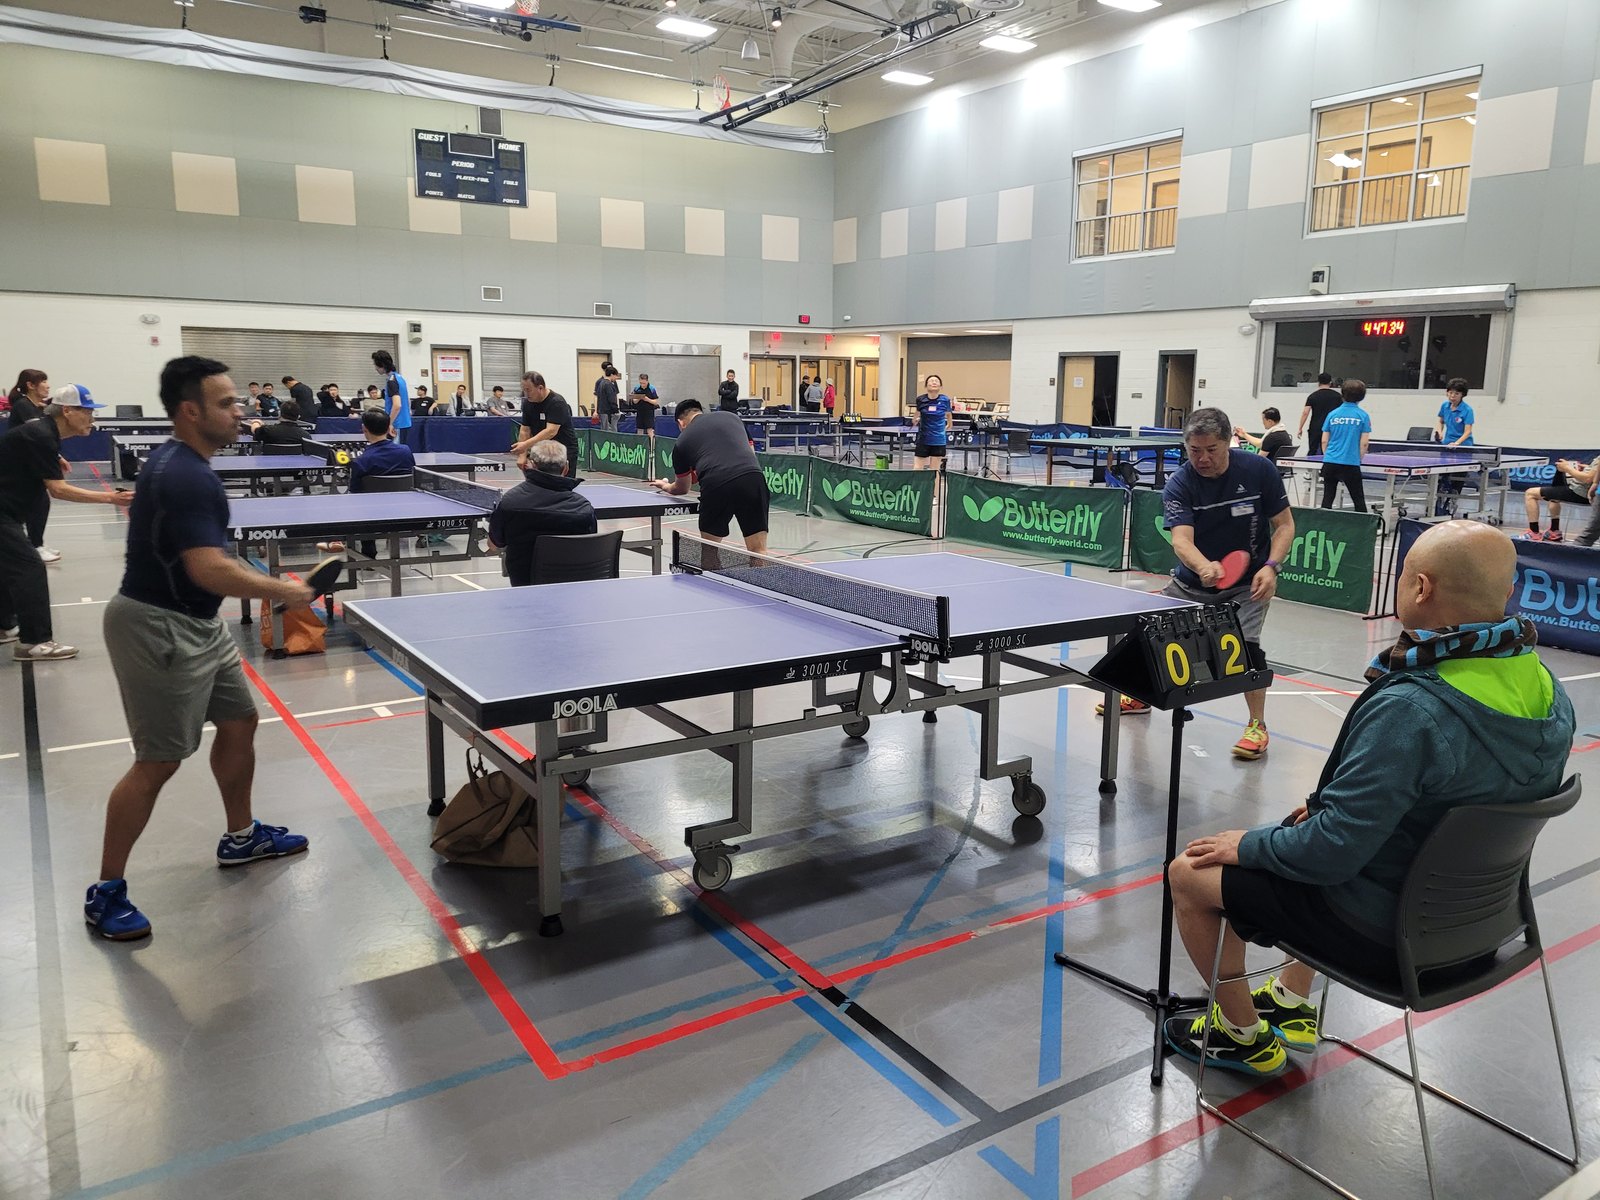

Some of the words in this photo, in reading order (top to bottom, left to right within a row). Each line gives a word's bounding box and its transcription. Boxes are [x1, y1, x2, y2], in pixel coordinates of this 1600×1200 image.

[417, 132, 445, 142] GUEST
[498, 142, 521, 152] HOME
[451, 160, 475, 168] PERIOD
[336, 451, 350, 464] 6
[610, 441, 647, 468] Butterfly
[763, 466, 804, 500] tterfly
[851, 480, 921, 517] Butterfly
[663, 506, 690, 516] JOOLA
[849, 508, 921, 524] www.butterfly-world.com
[437, 519, 455, 528] 3000
[458, 519, 467, 527] SC
[1003, 498, 1102, 542] Butterfly
[248, 529, 287, 540] JOOLA
[1002, 530, 1102, 551] www.butterfly-world.com
[1283, 530, 1347, 578] rfly
[911, 638, 940, 655] JOOLA
[988, 635, 1012, 650] 3000
[1016, 633, 1027, 646] SC
[1220, 633, 1245, 676] 2
[802, 661, 830, 677] 3000
[836, 659, 849, 672] SC
[1165, 642, 1190, 686] 0
[552, 693, 618, 719] JOOLA
